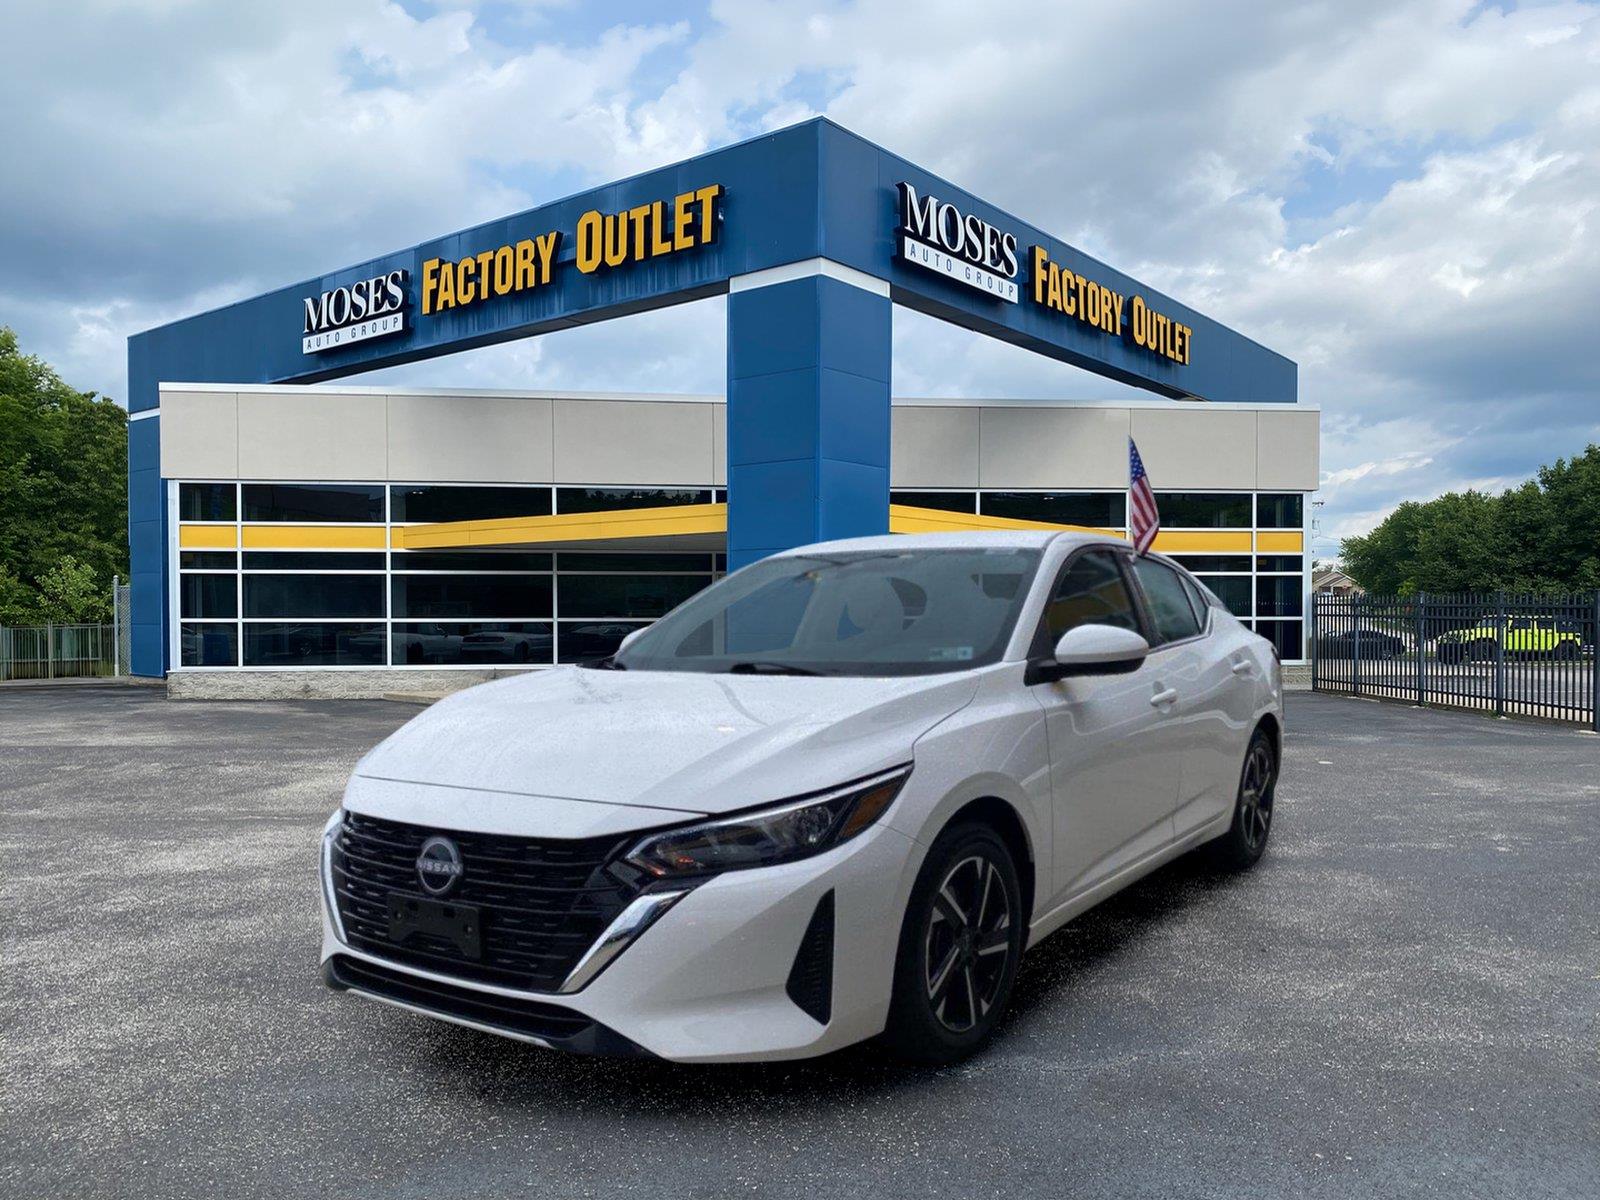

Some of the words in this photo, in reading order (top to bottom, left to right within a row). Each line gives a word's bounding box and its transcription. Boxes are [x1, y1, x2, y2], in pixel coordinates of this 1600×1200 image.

[422, 231, 559, 315] FACTORY
[576, 184, 721, 274] OUTLET
[904, 182, 1018, 278] MOSES
[910, 243, 953, 272] AUTO
[965, 266, 1014, 297] GROUP
[303, 269, 403, 333] MOSES
[306, 332, 340, 350] AUTO
[351, 316, 399, 339] GROUP
[1034, 245, 1124, 336] FACTORY
[1132, 295, 1193, 365] OUTLET
